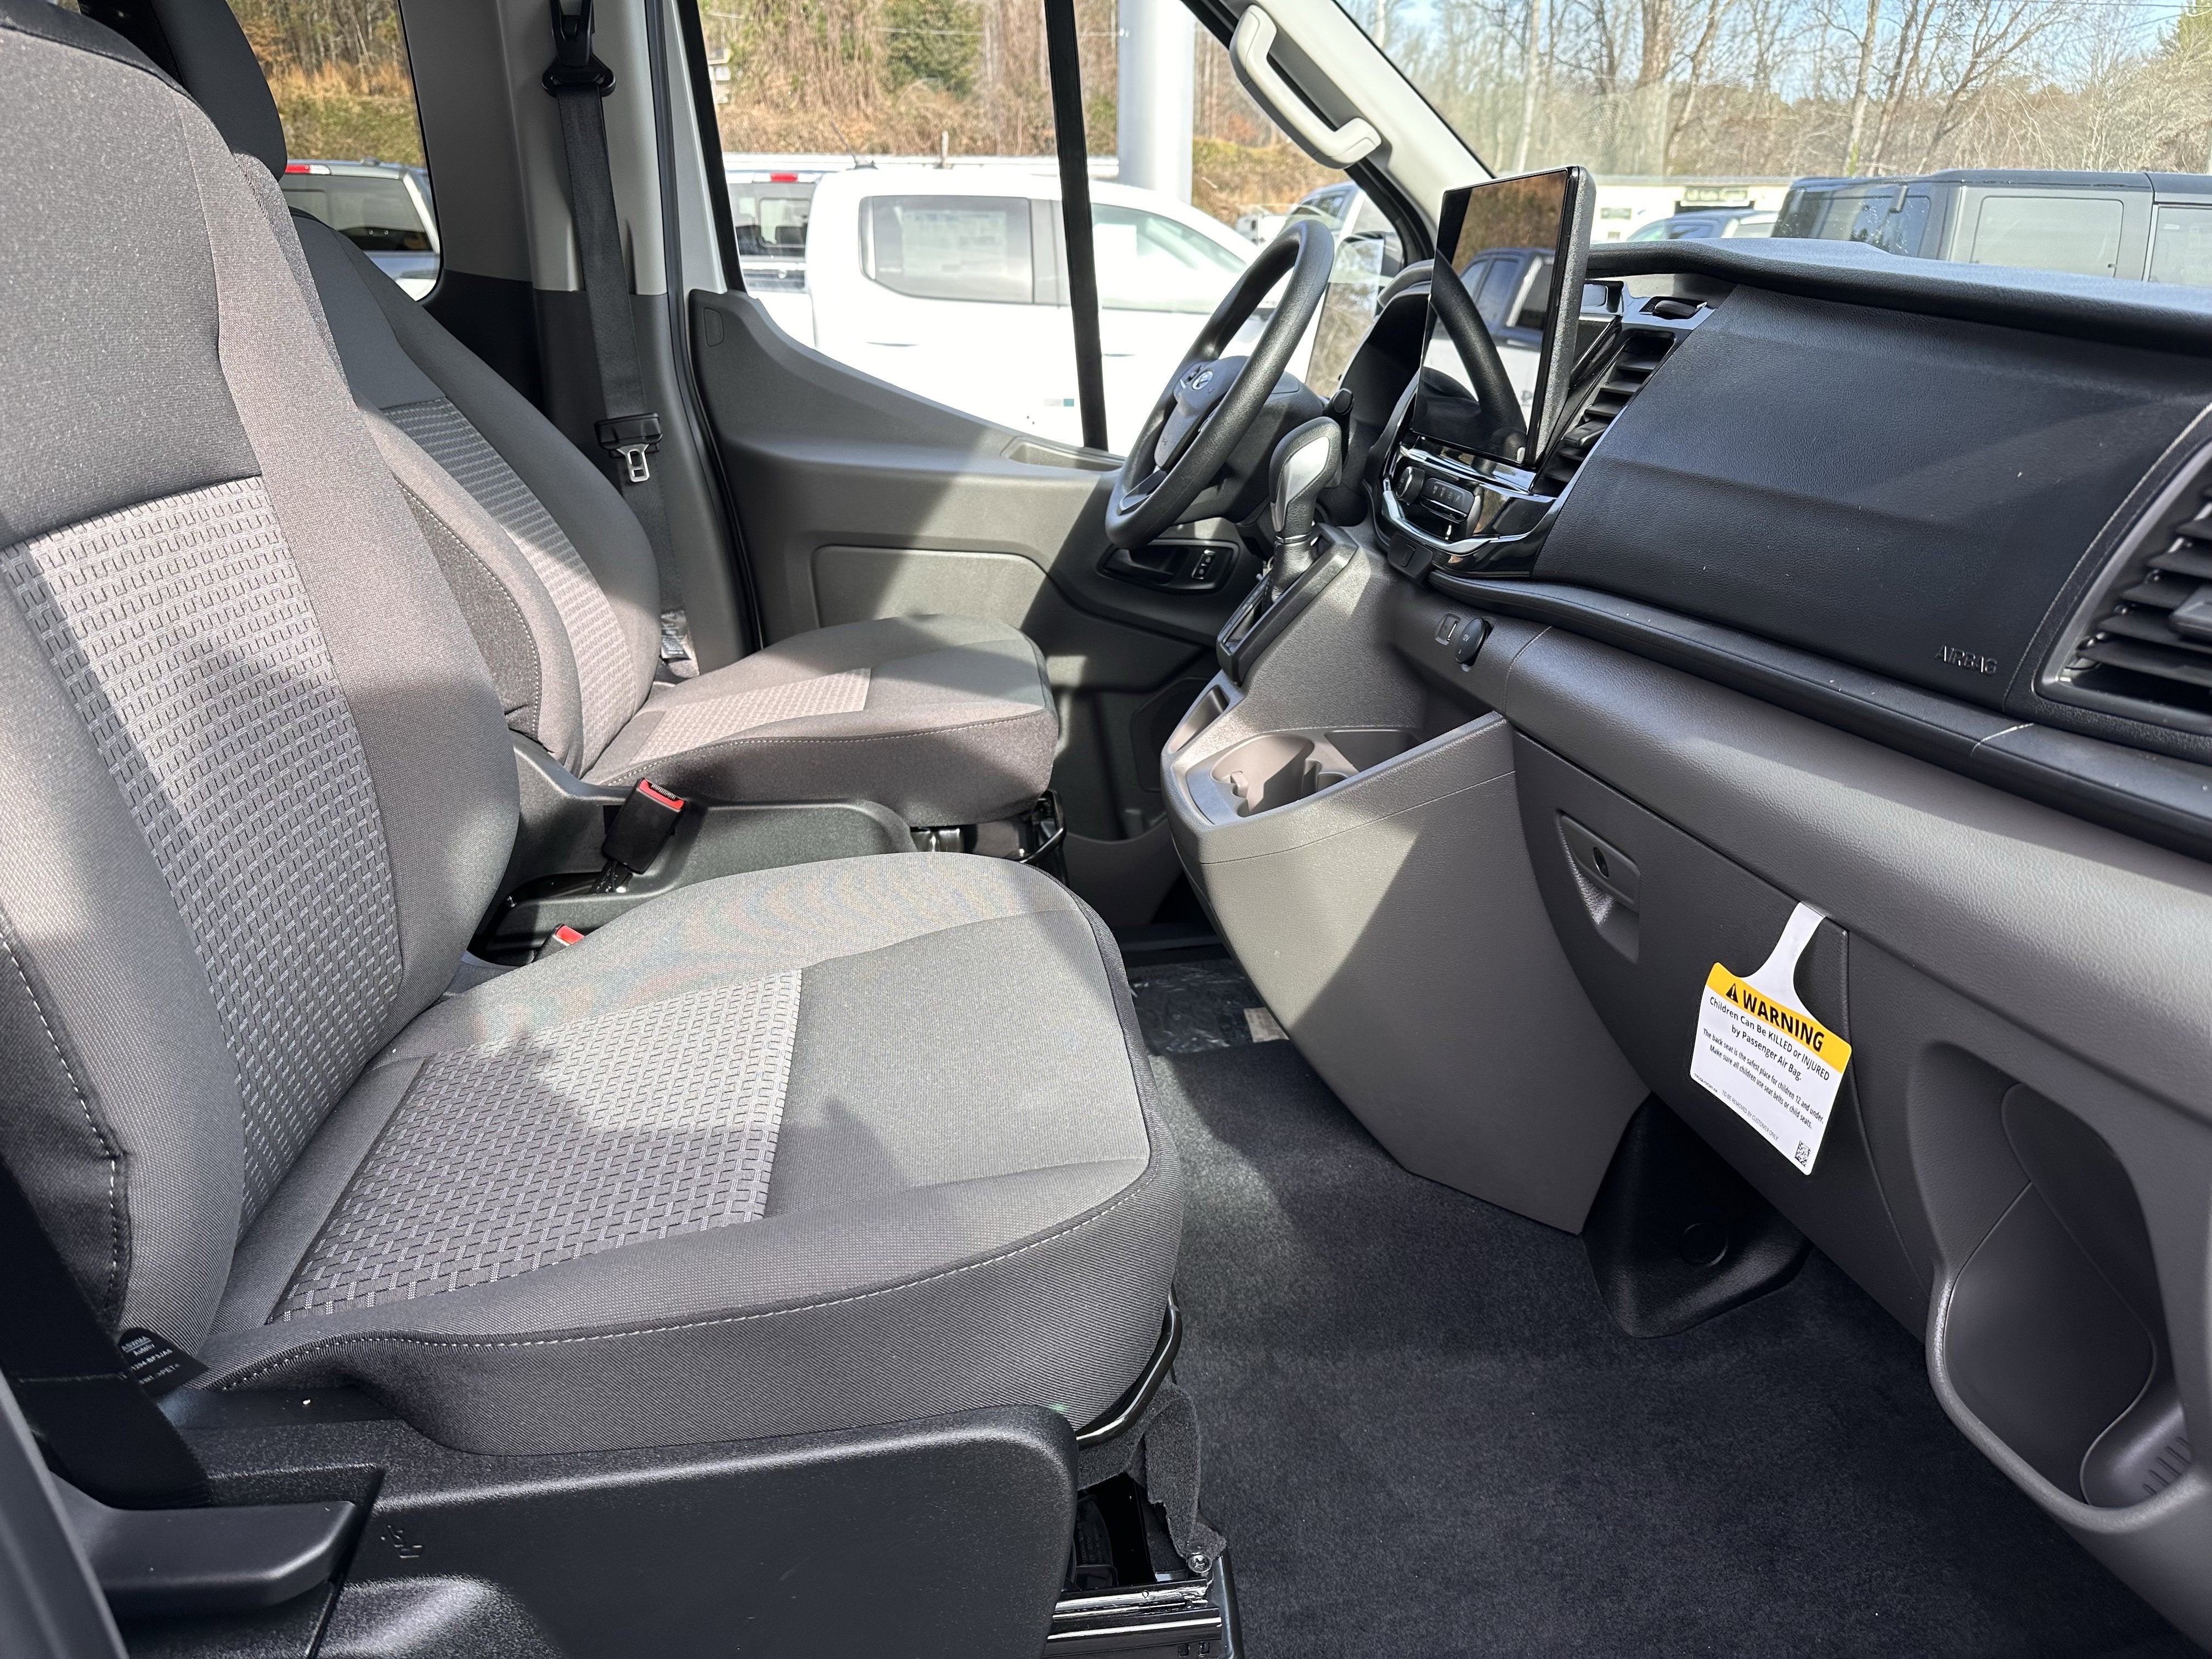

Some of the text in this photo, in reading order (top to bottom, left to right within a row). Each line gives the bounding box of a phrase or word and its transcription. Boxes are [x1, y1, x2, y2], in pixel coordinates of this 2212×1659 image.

[1935, 645, 1997, 675] AIRBAG
[1710, 996, 1830, 1081] Children Can Be KILLED or INJURED
[1731, 1024, 1802, 1081] by Passenger Air Bag.
[1743, 989, 1825, 1052] WARNING
[1703, 1028, 1712, 1039] The
[1712, 1034, 1723, 1046] back
[1724, 1042, 1734, 1053] seat
[1734, 1047, 1738, 1056] is
[1747, 1058, 1760, 1071] safest
[1759, 1068, 1771, 1081] place
[1778, 1081, 1795, 1100] children
[1796, 1095, 1801, 1104] 12
[1801, 1101, 1810, 1111] and
[1810, 1108, 1824, 1124] under.
[1709, 1044, 1722, 1058] Make
[1723, 1054, 1733, 1065] sure
[1739, 1065, 1756, 1083] children
[1764, 1085, 1773, 1097] seat
[1773, 1091, 1784, 1105] belts
[1784, 1101, 1789, 1109] or
[1789, 1105, 1801, 1118] child
[1800, 1115, 1812, 1130] seats.
